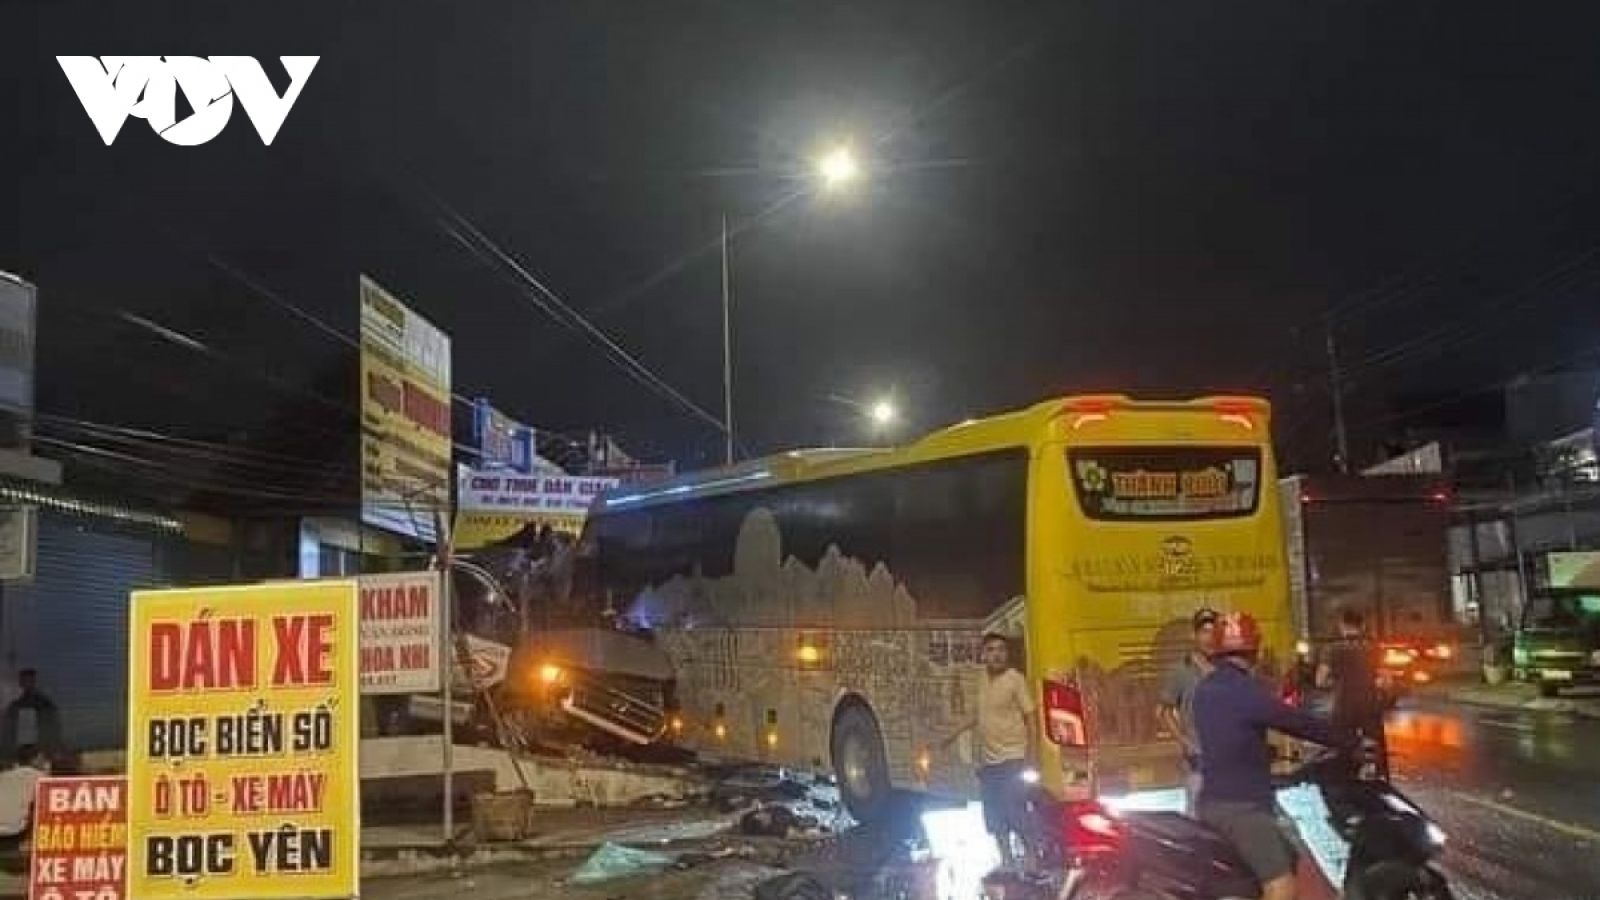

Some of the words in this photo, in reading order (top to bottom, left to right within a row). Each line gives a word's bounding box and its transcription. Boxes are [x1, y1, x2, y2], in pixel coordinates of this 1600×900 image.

[150, 607, 255, 691] DÁN
[273, 614, 333, 686] XE
[149, 719, 206, 766] BỌC
[217, 700, 283, 755] BIỂN
[293, 696, 340, 751] SỐ
[49, 783, 119, 811] BÁN
[154, 774, 173, 817] Ô
[180, 772, 209, 815] TÔ
[232, 778, 261, 812] XE
[268, 771, 326, 810] MÁY
[38, 858, 67, 883] XE
[73, 850, 125, 881] MÁY
[148, 834, 233, 888] BỌC
[249, 824, 332, 871] YÊN
